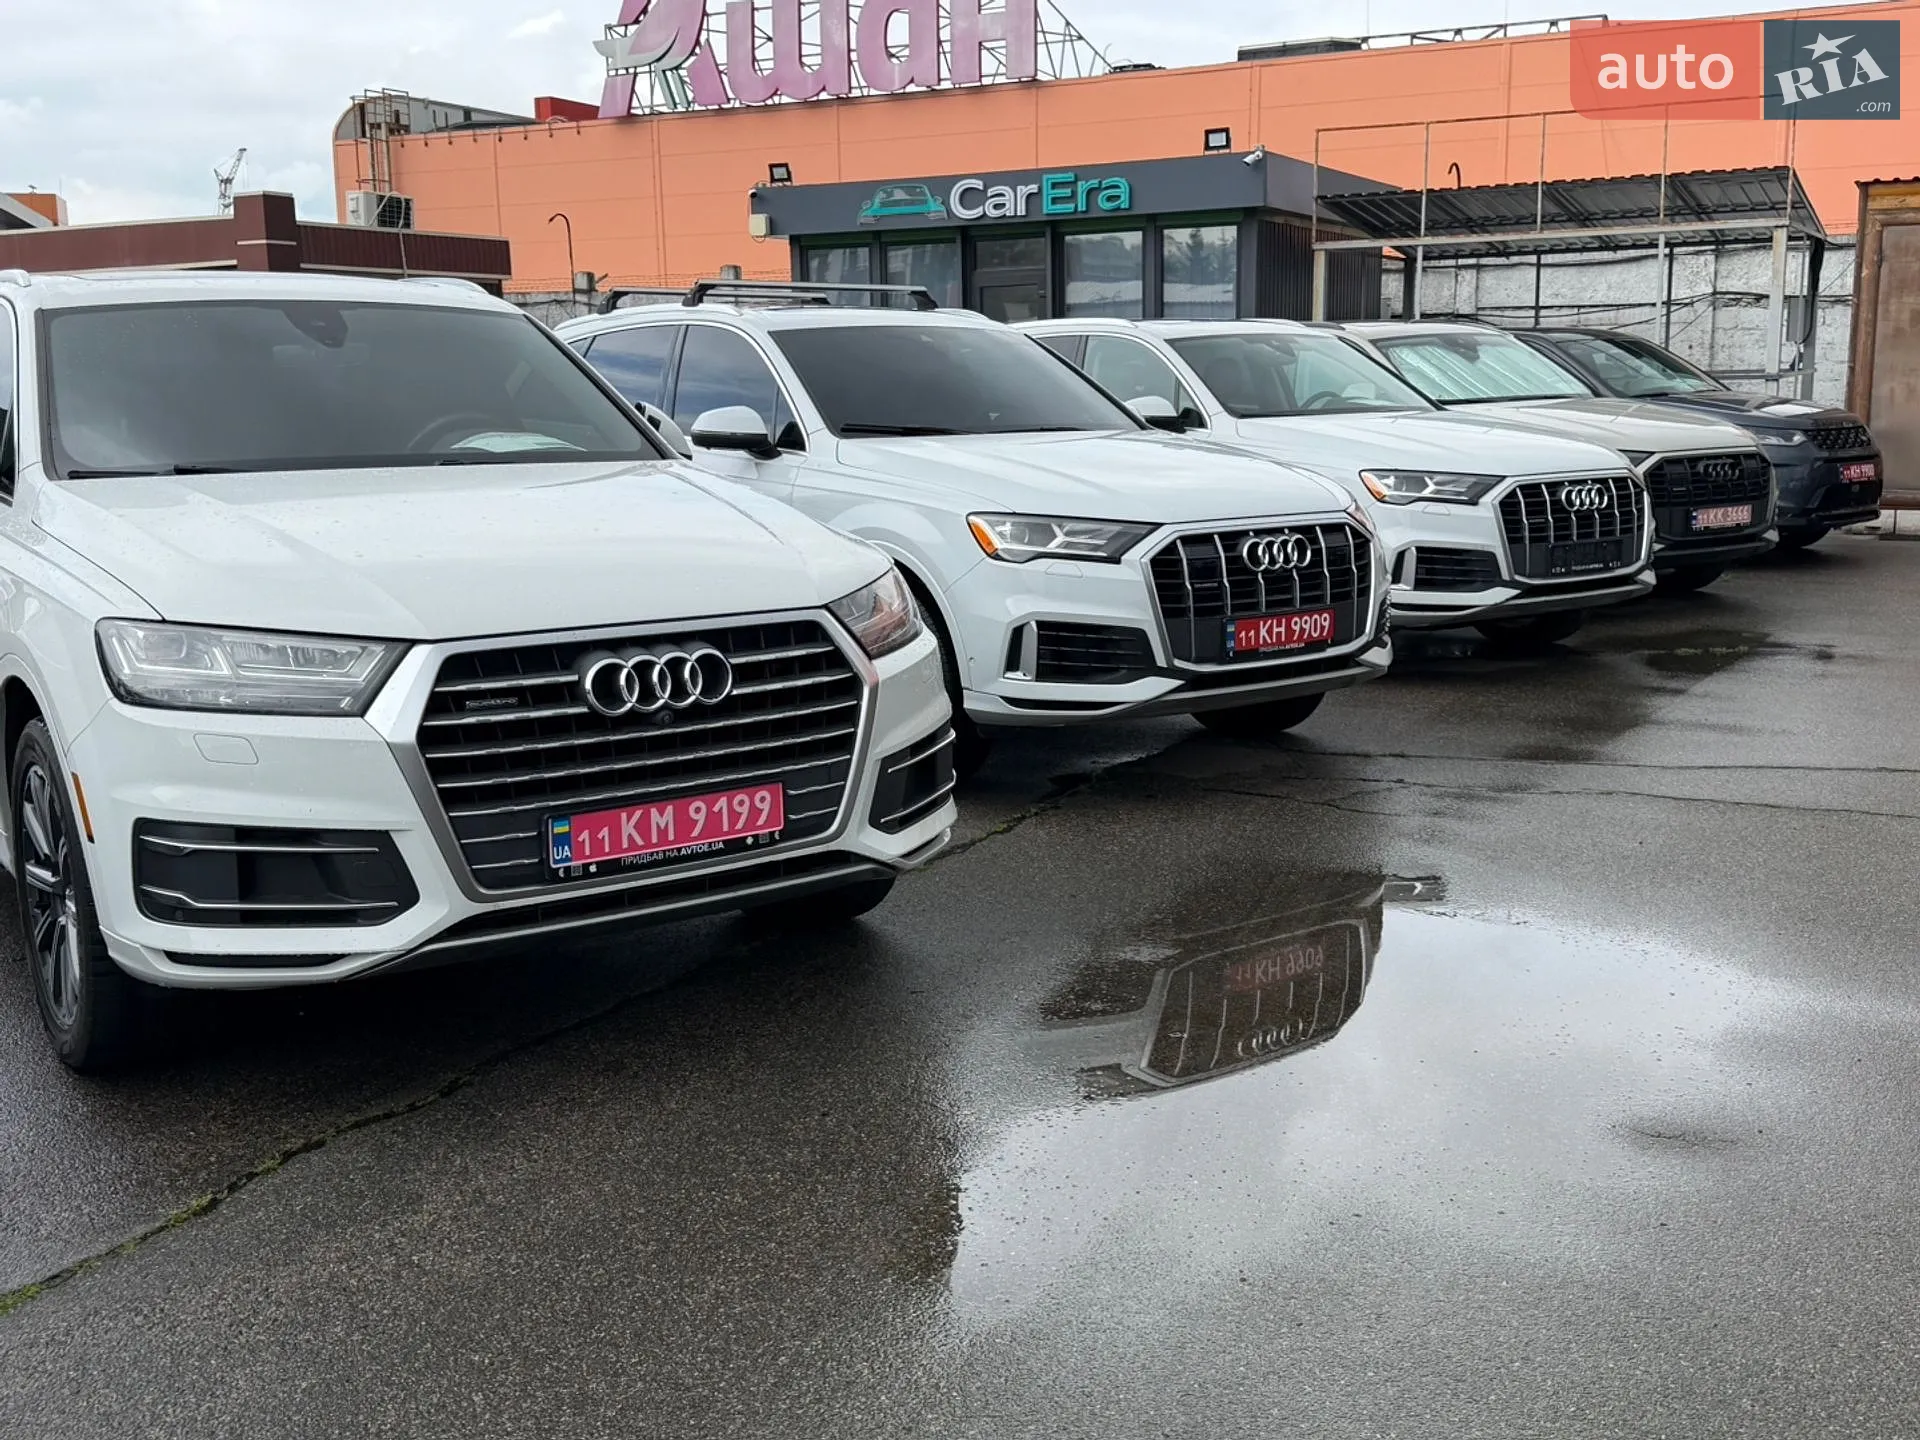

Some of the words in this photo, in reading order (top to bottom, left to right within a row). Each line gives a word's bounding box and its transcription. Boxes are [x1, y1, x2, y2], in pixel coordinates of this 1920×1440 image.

[950, 172, 1131, 219] CarEra
[1291, 613, 1330, 640] 9909
[689, 790, 772, 838] 9199
[553, 845, 571, 860] UA
